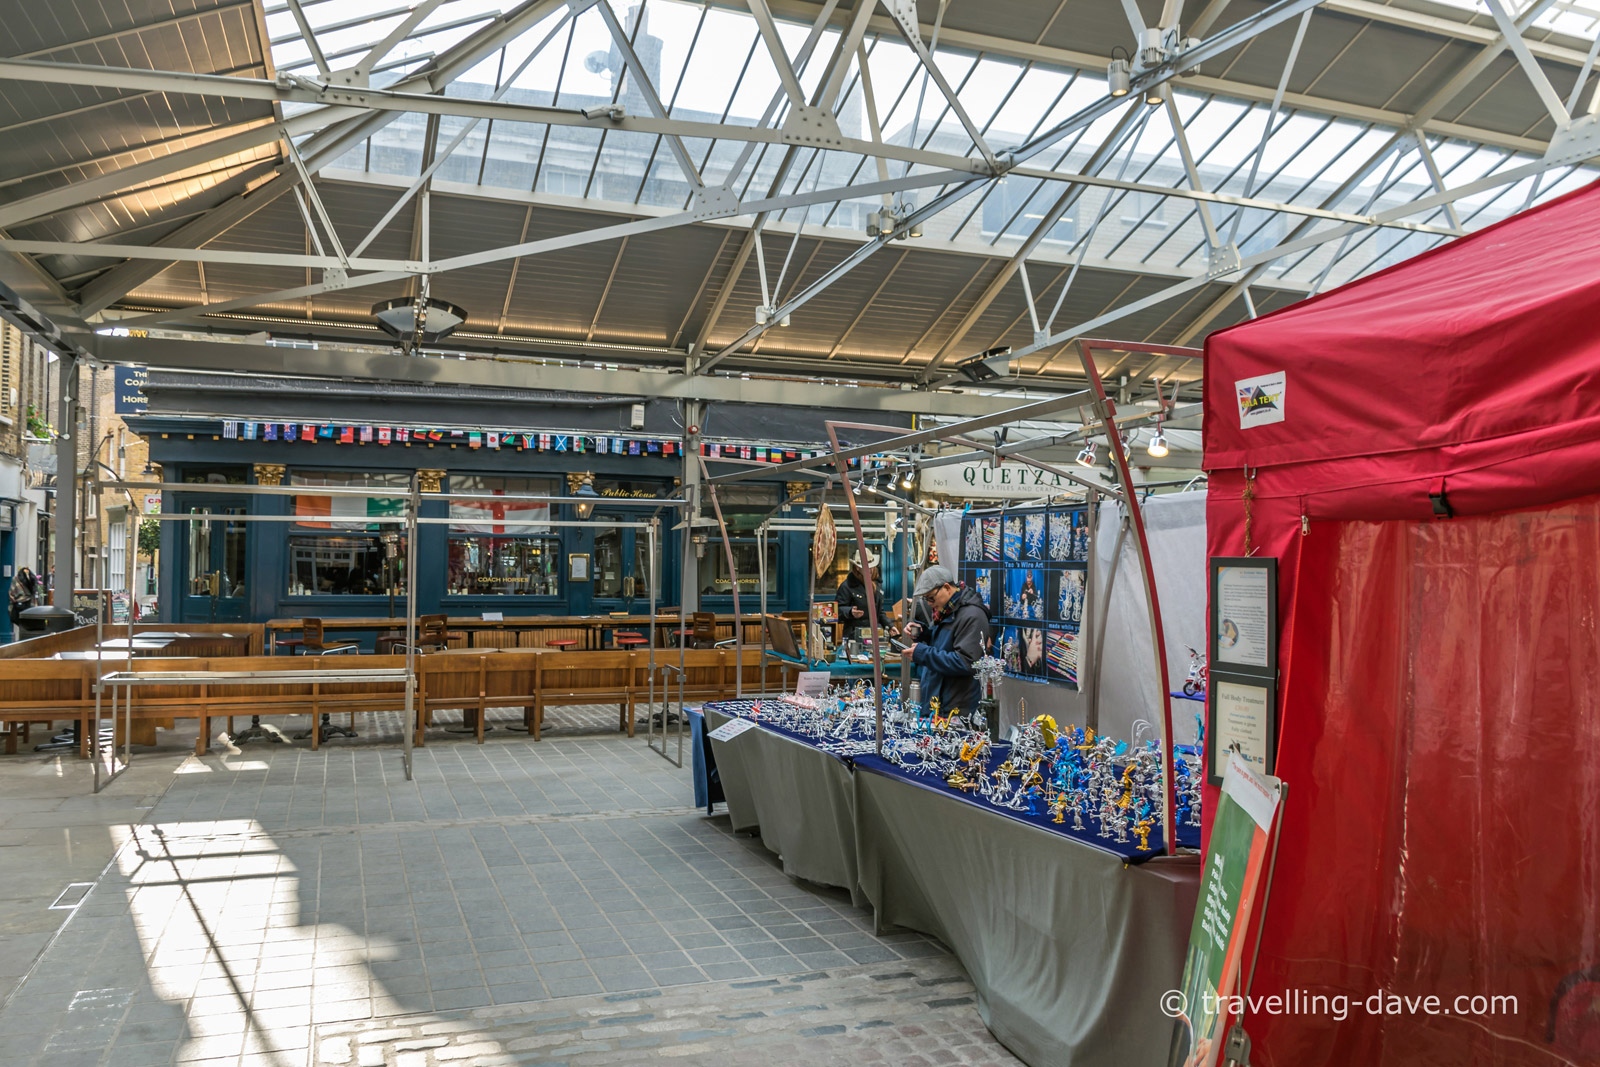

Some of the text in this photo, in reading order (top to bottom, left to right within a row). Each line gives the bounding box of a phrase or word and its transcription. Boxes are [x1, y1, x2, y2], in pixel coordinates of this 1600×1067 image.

[1241, 393, 1280, 408] GALA TENT
[963, 466, 1078, 487] QUETZAL
[601, 487, 657, 498] Public House
